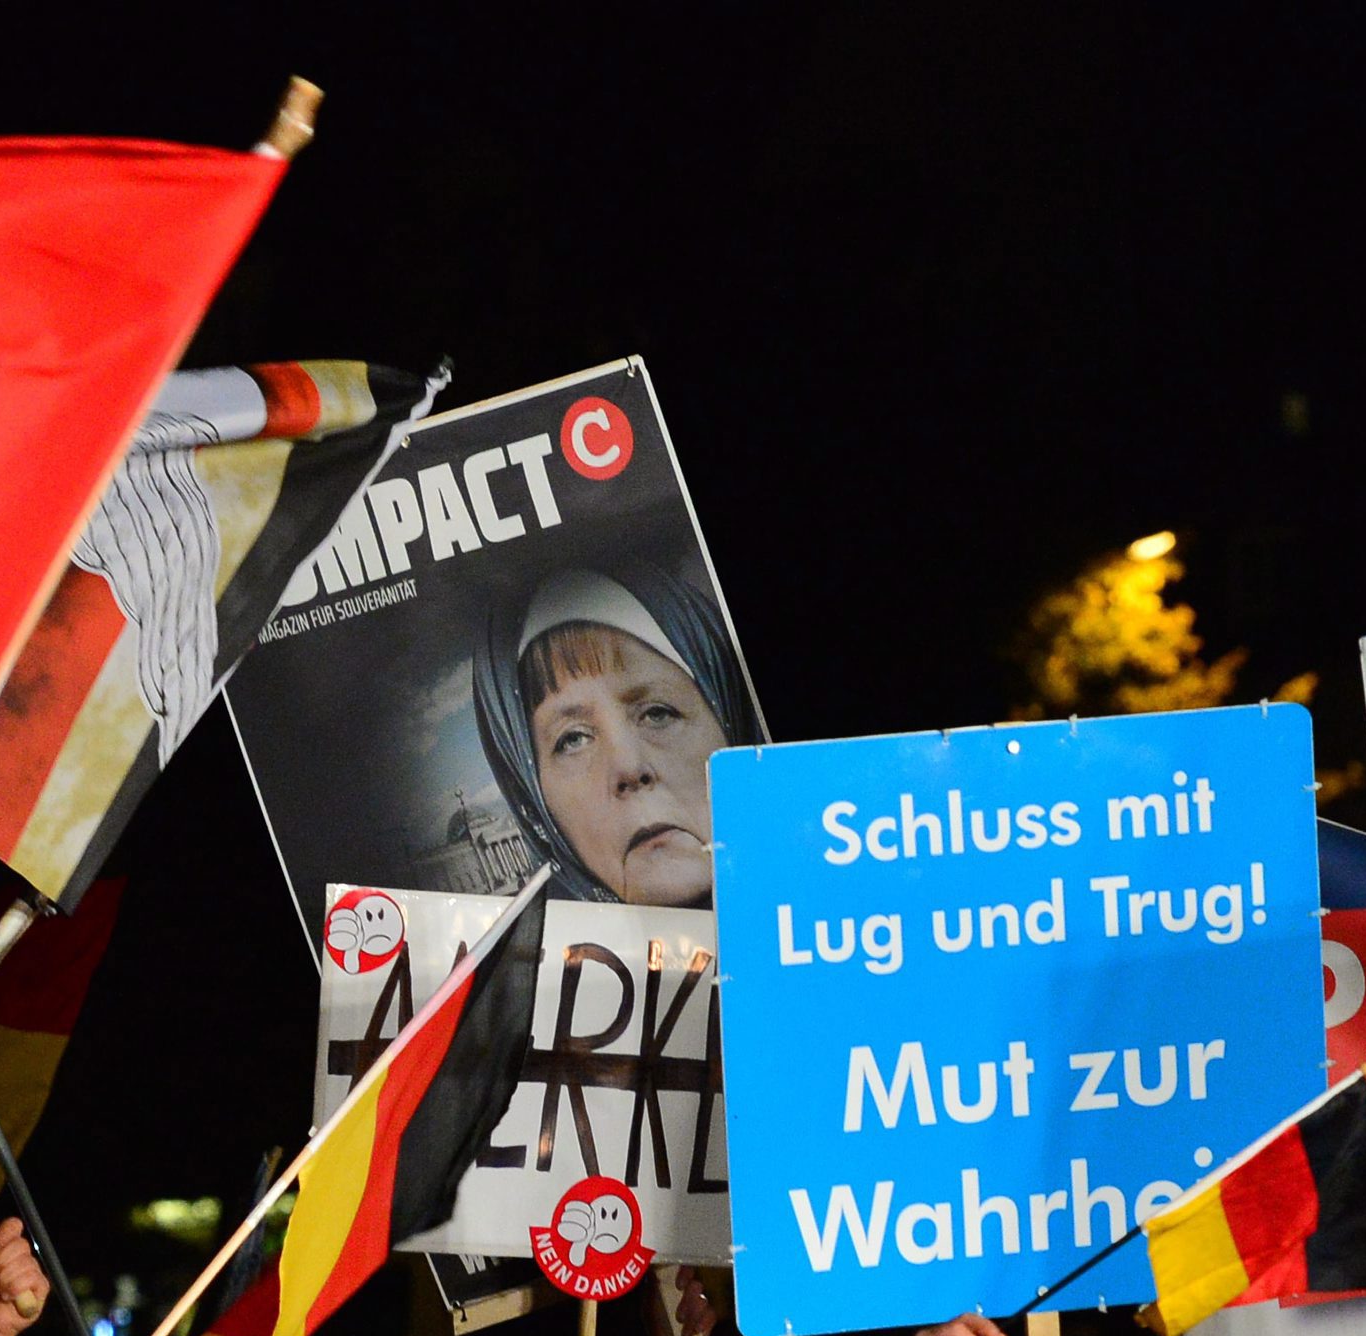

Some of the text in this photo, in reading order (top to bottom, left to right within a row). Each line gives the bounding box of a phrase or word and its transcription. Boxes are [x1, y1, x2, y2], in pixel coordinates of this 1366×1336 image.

[258, 578, 418, 645] MAGAZIN FÜR SOUVERÄNITÄT
[822, 771, 1215, 865] Schluss mit
[776, 862, 1267, 975] Lug und Trug!
[842, 1038, 1226, 1133] Mut zur
[789, 1147, 1232, 1272] Wahrhe
[535, 1233, 573, 1285] NEIN
